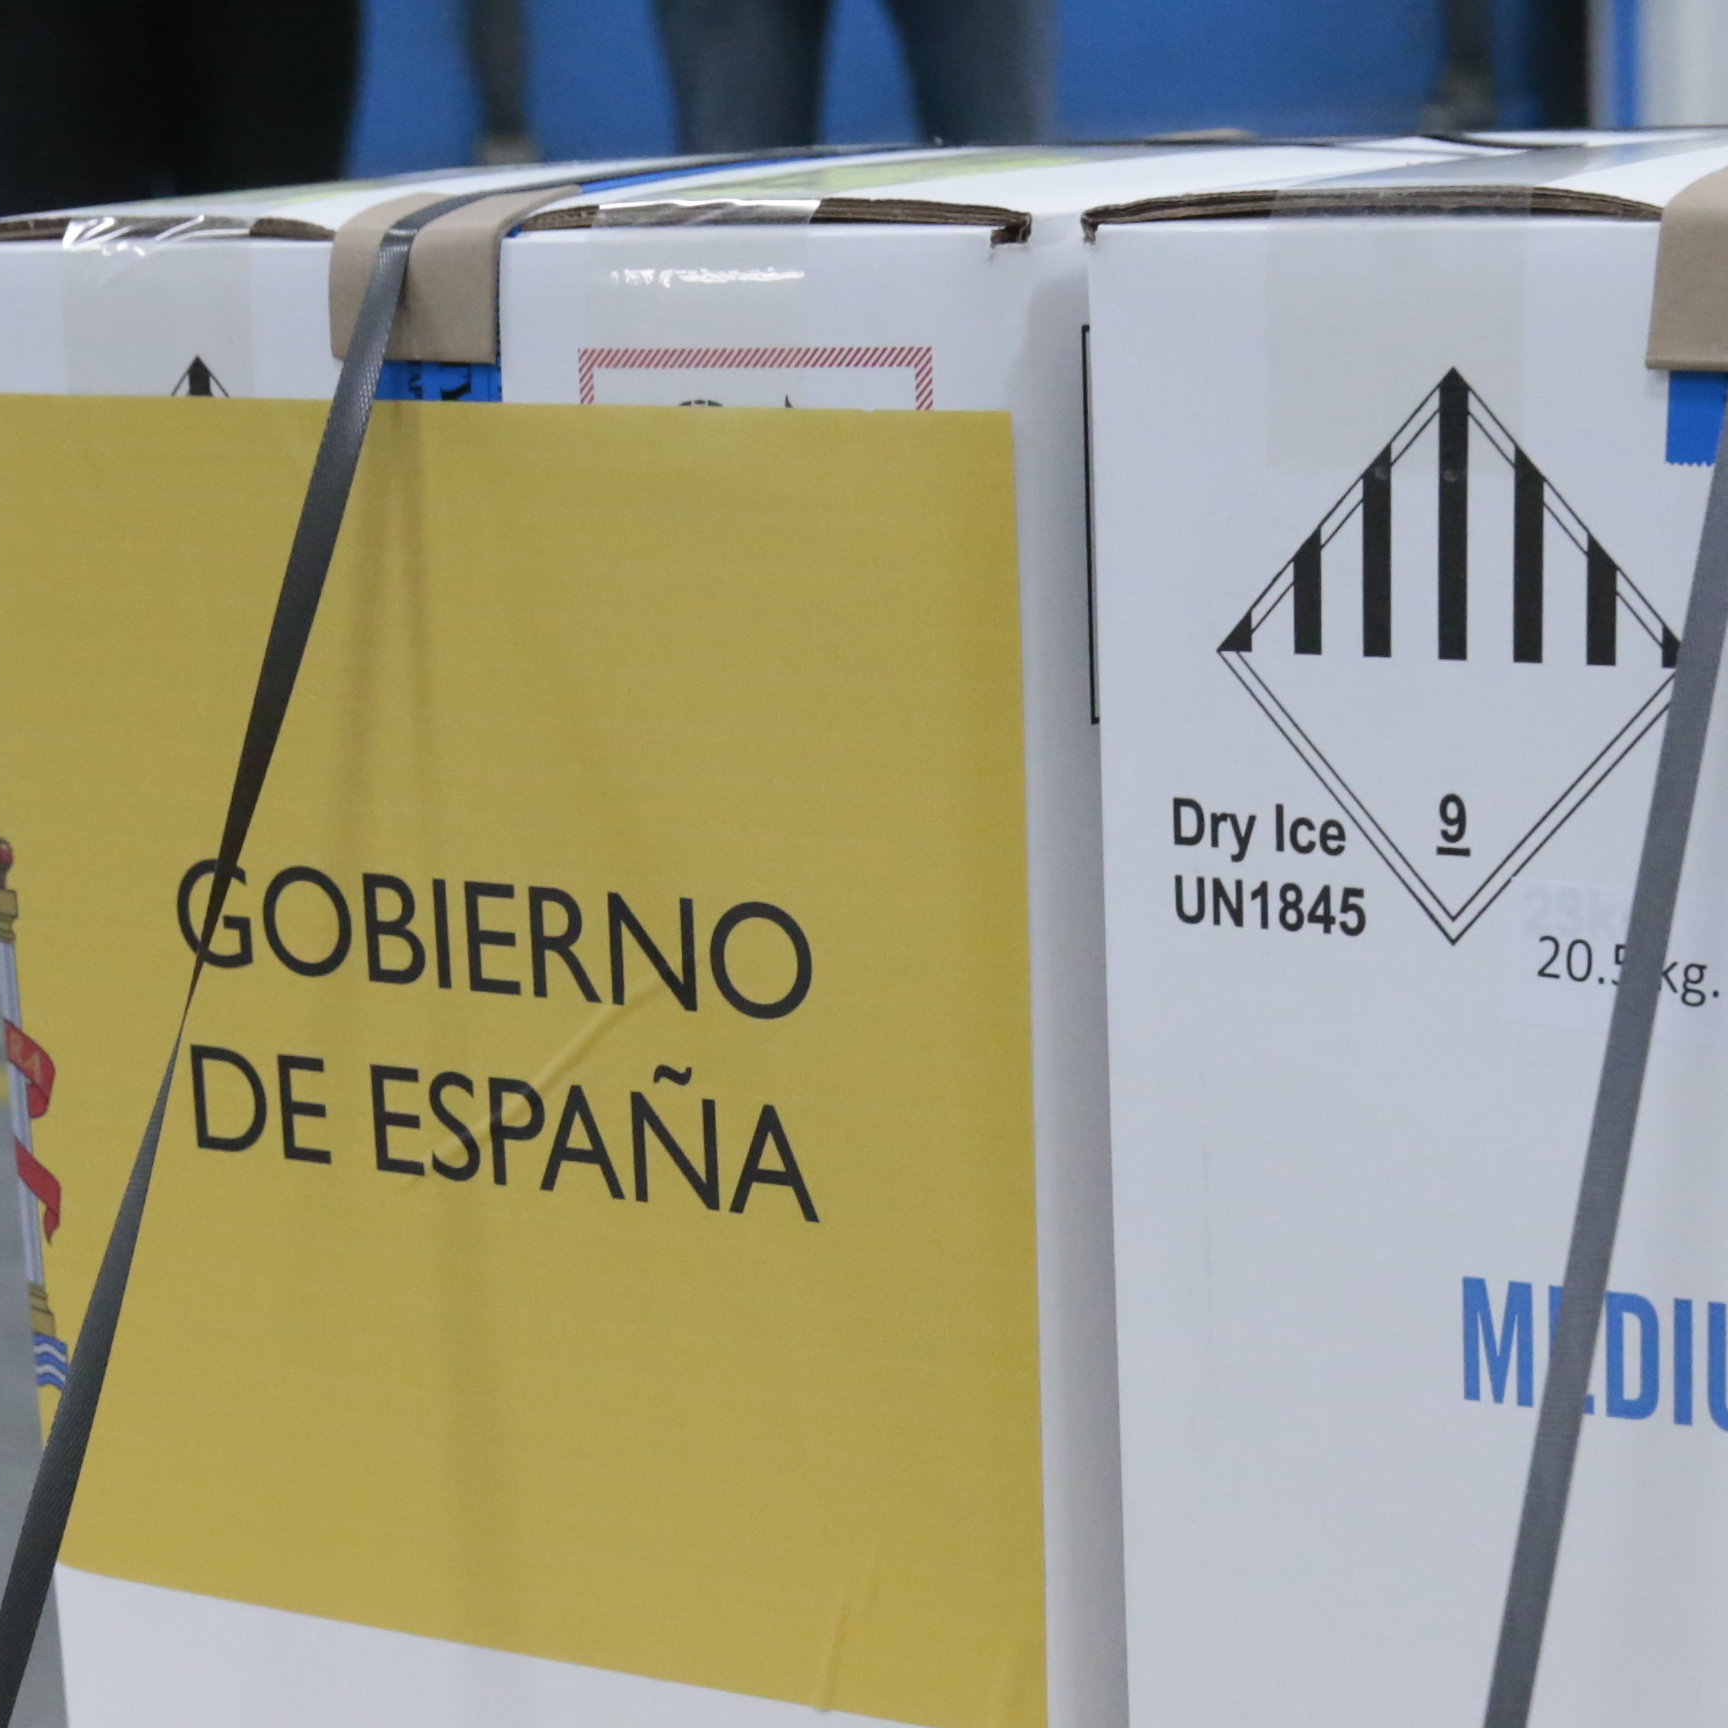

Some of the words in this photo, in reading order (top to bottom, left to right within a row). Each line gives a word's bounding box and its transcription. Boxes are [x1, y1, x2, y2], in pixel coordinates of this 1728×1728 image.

[1172, 797, 1256, 862] Dry
[1275, 803, 1347, 857] Ice
[1438, 794, 1468, 844] 9
[1173, 875, 1367, 937] UN1845
[177, 858, 812, 1020] GOBIERNO
[189, 1044, 332, 1165] DE
[369, 1063, 820, 1224] ESPAÑA
